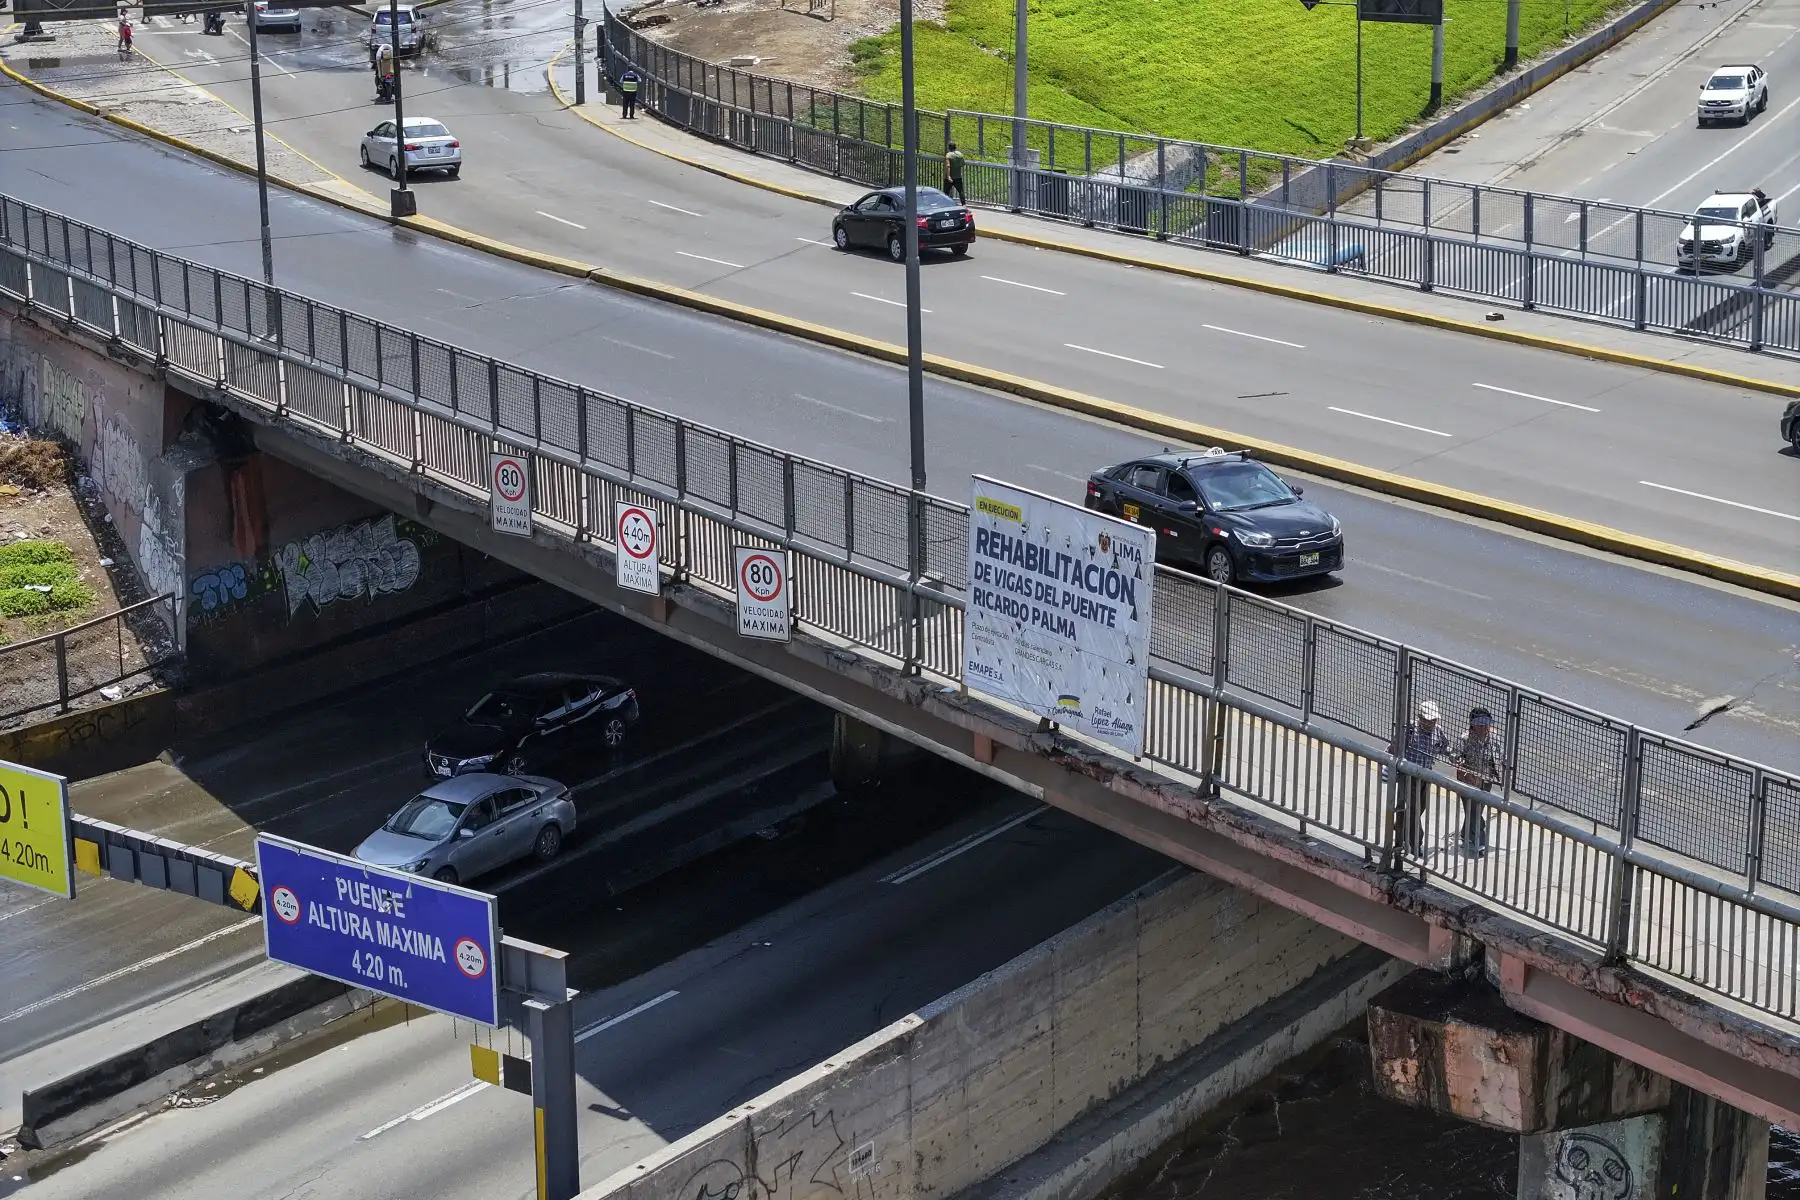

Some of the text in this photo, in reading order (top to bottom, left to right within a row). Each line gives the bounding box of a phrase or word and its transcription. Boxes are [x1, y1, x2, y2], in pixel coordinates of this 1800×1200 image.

[501, 468, 519, 488] 80
[504, 488, 517, 496] Kph
[495, 504, 528, 518] VELOCIDAD
[980, 501, 988, 510] EN
[496, 516, 528, 531] MAXIMA
[623, 525, 650, 543] 4.40m
[1112, 540, 1142, 564] LIMA
[623, 559, 653, 576] ALTURA
[750, 563, 773, 586] 80
[976, 527, 1135, 607] REHABILITACION
[623, 572, 653, 590] MAXIMA
[755, 586, 770, 596] Kph
[974, 560, 1117, 629] DE VIGAS DEL PUENTE
[743, 605, 785, 619] VELOCIDAD
[973, 586, 1077, 642] RICARDO PALMA
[743, 618, 785, 635] MAXIMA
[968, 660, 994, 678] EMAPE
[1094, 706, 1112, 718] Rafael
[1111, 717, 1134, 735] Aliaga
[1, 838, 54, 874] 4.20m.
[275, 898, 297, 912] 4.20m
[308, 900, 446, 964] ALTURA MAXIMA
[459, 951, 482, 965] 4.20m
[352, 949, 408, 989] 4.20 m.
